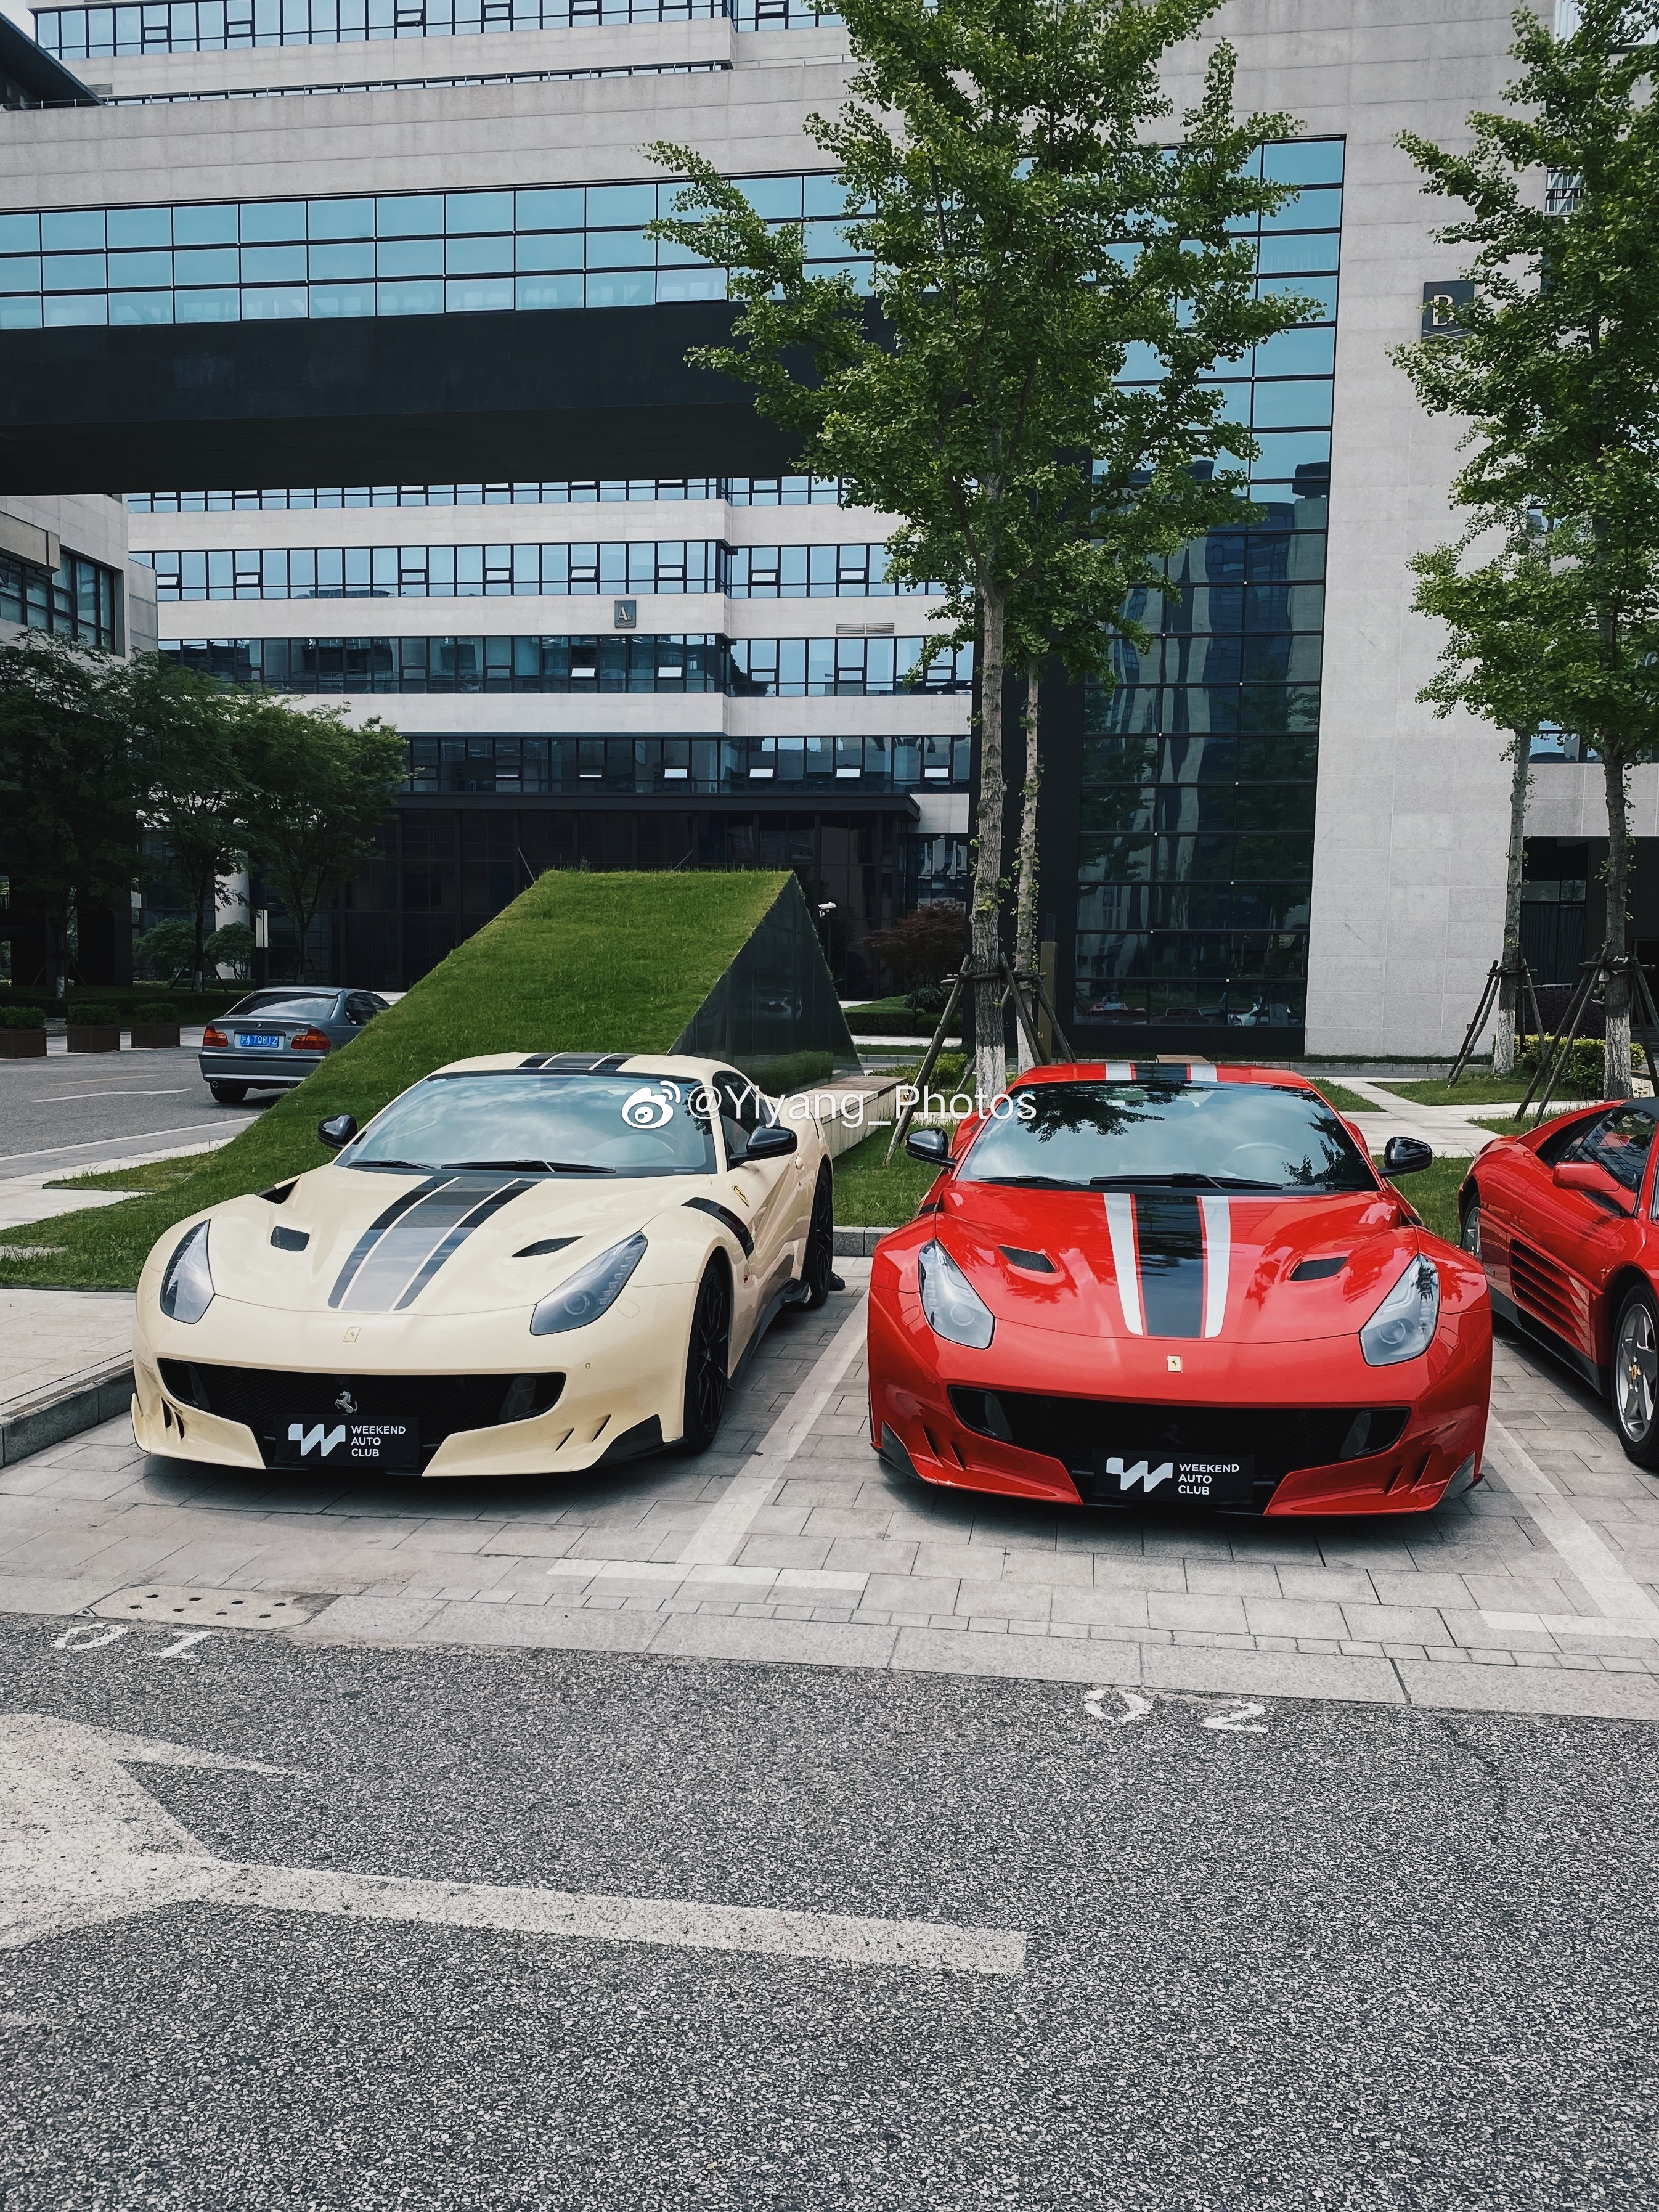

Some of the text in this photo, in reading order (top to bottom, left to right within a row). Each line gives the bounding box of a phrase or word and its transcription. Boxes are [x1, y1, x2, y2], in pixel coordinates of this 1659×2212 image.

[351, 1426, 406, 1434] WEEKEND
[351, 1437, 381, 1445] AUTO
[351, 1448, 380, 1457] CLUB
[1179, 1463, 1239, 1472] WEEKEND
[1178, 1474, 1212, 1484] AUTO
[1178, 1485, 1210, 1495] CLUB
